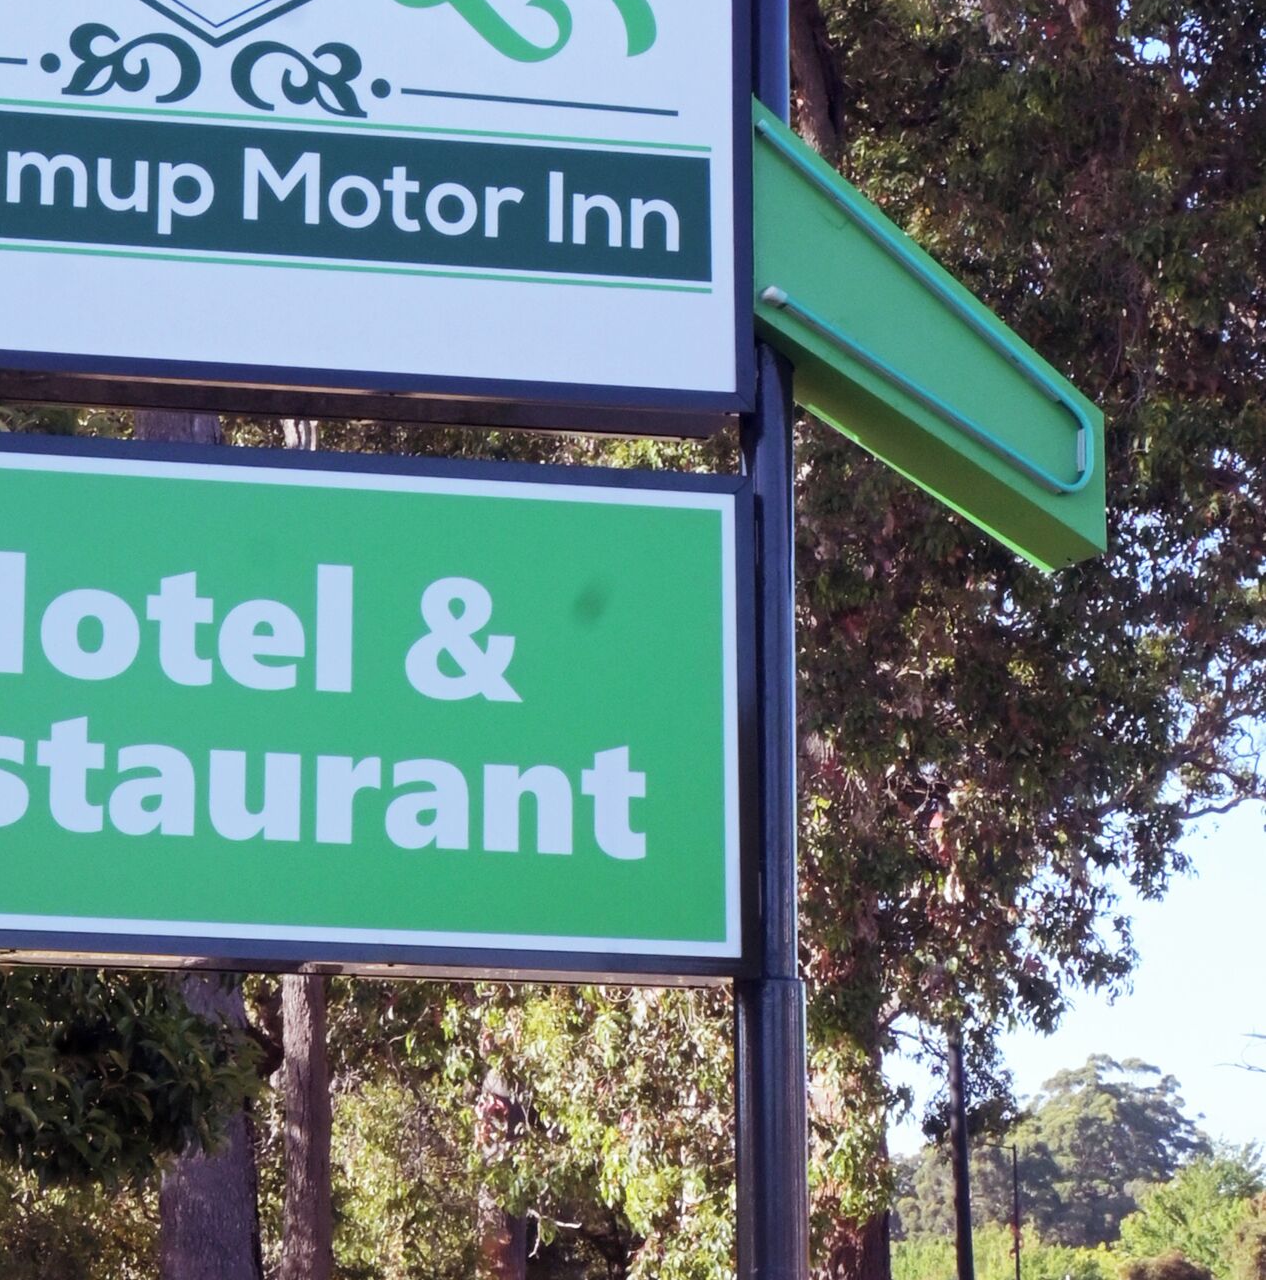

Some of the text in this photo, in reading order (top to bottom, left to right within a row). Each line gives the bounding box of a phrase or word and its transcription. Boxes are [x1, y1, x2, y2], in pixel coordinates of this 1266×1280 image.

[242, 147, 526, 238] Motor
[547, 171, 681, 253] Inn
[405, 576, 524, 703] &
